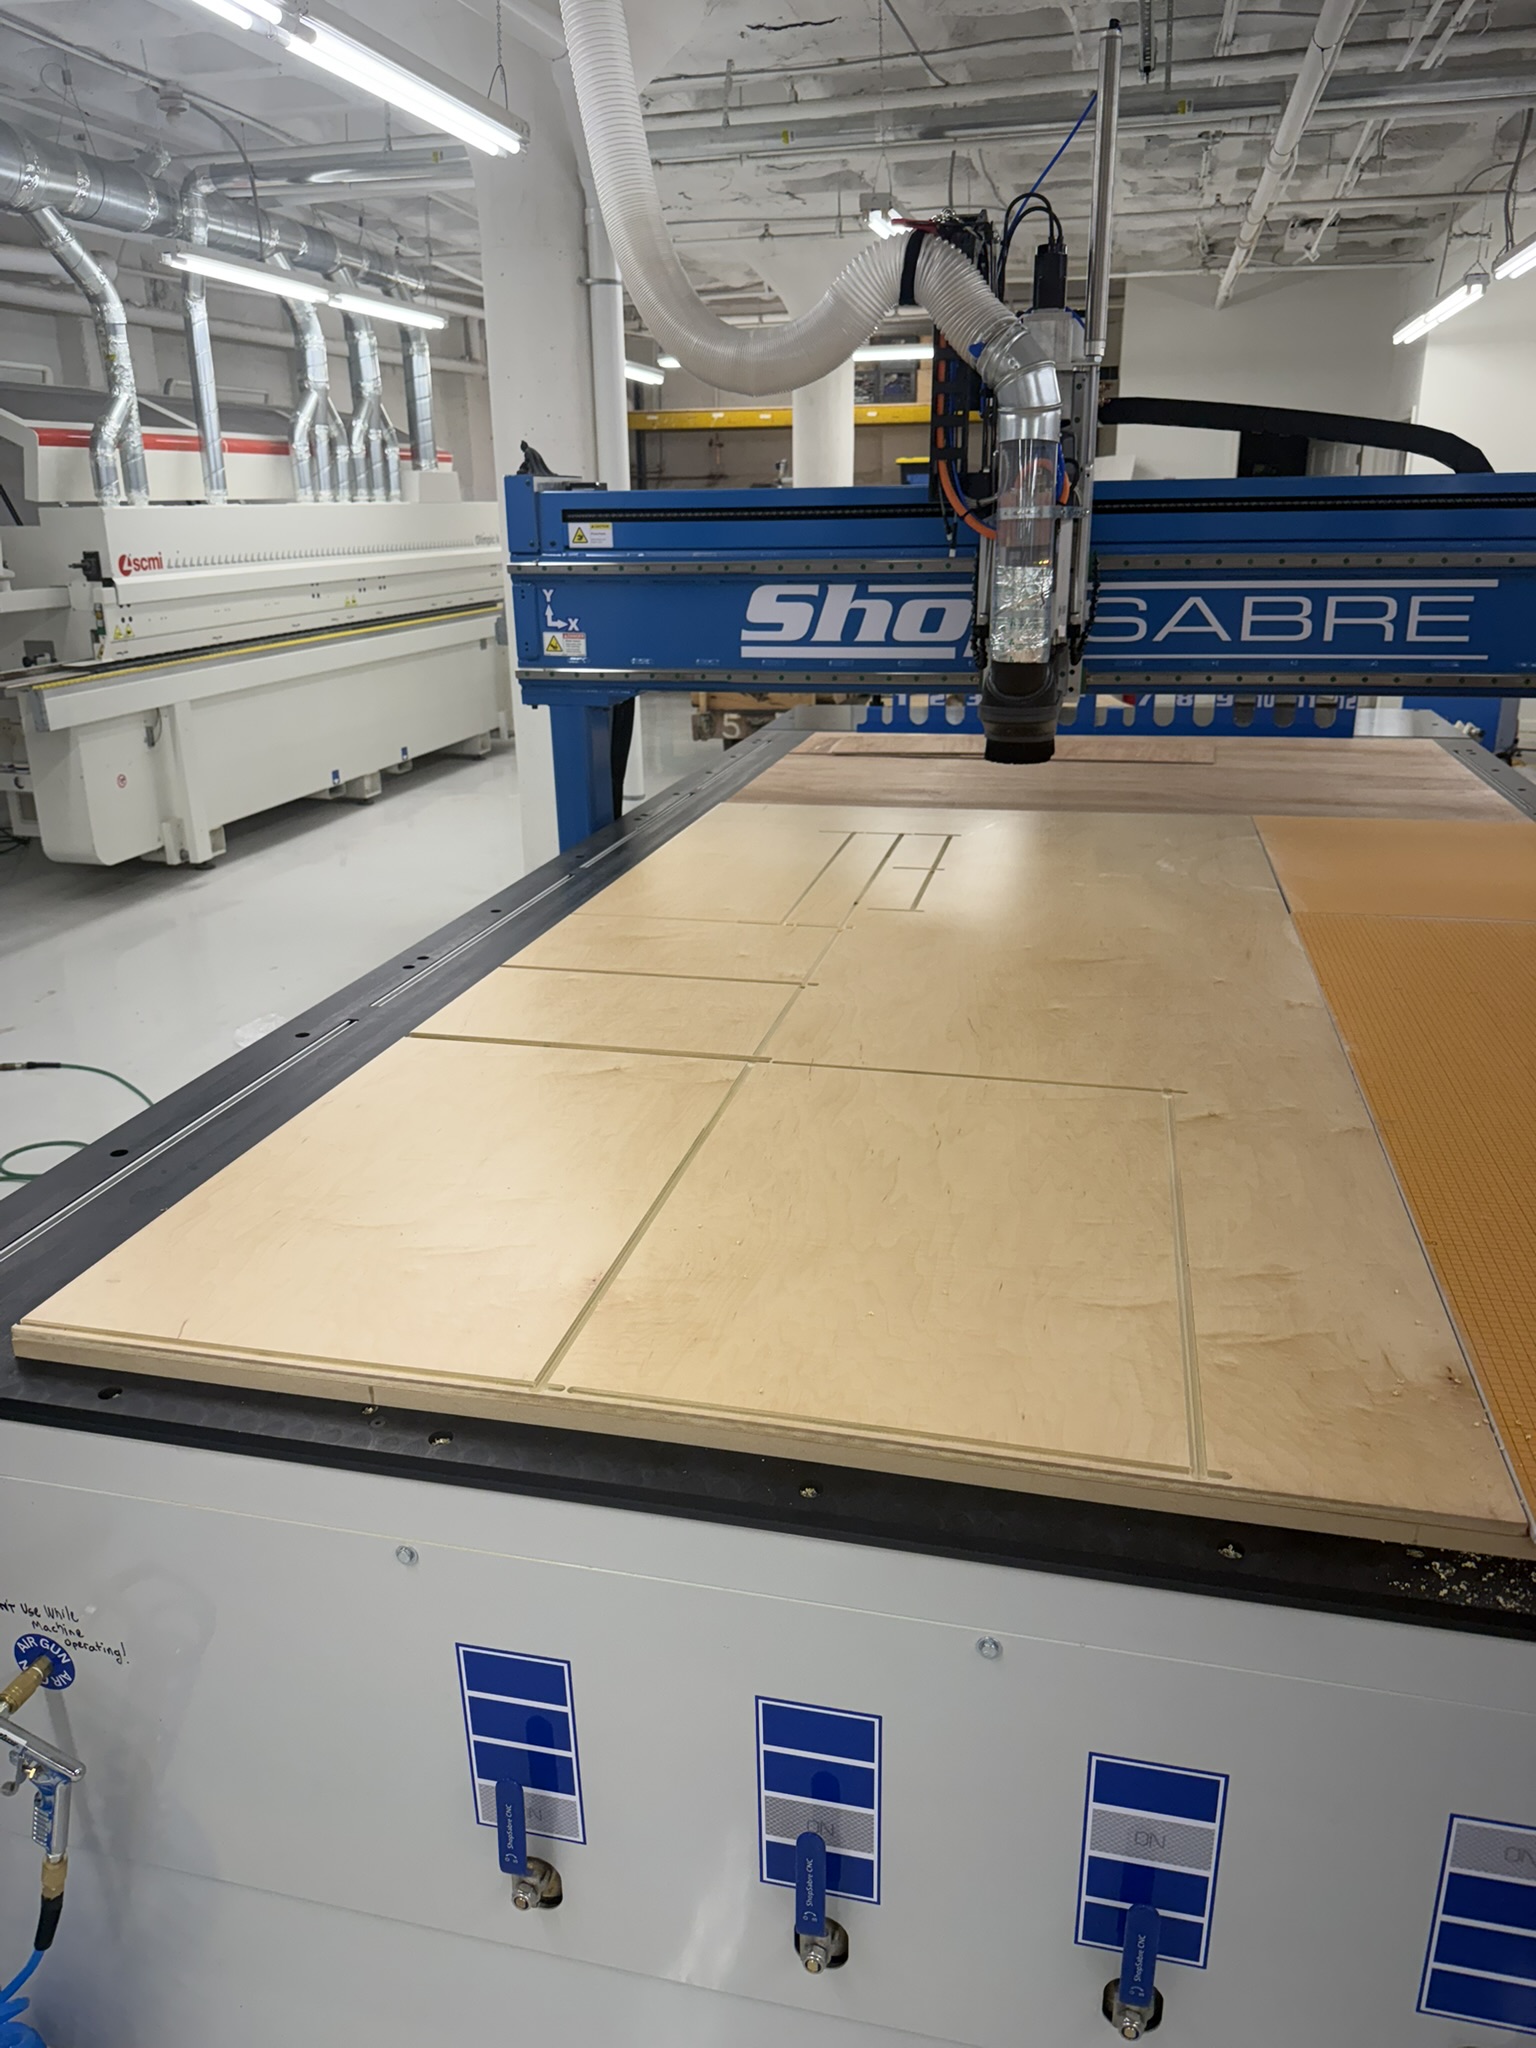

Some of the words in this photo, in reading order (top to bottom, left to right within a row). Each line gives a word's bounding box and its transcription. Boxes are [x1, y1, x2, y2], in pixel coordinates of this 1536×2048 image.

[132, 551, 164, 571] scmi
[542, 588, 554, 603] Y
[567, 618, 579, 631] X
[741, 584, 974, 658] Sho
[722, 713, 741, 739] 5
[20, 1602, 41, 1618] Use
[43, 1604, 79, 1623] While
[32, 1620, 84, 1638] Machine
[16, 1636, 38, 1653] AIR
[39, 1638, 71, 1664] GUN
[51, 1670, 72, 1687] AIR
[505, 1803, 513, 1818] CNC
[506, 1819, 514, 1849] ShopSabre
[1134, 1830, 1166, 1849] ON
[805, 1858, 814, 1873] CNC
[805, 1873, 814, 1907] ShopSabre
[1137, 1934, 1147, 1949] CNC
